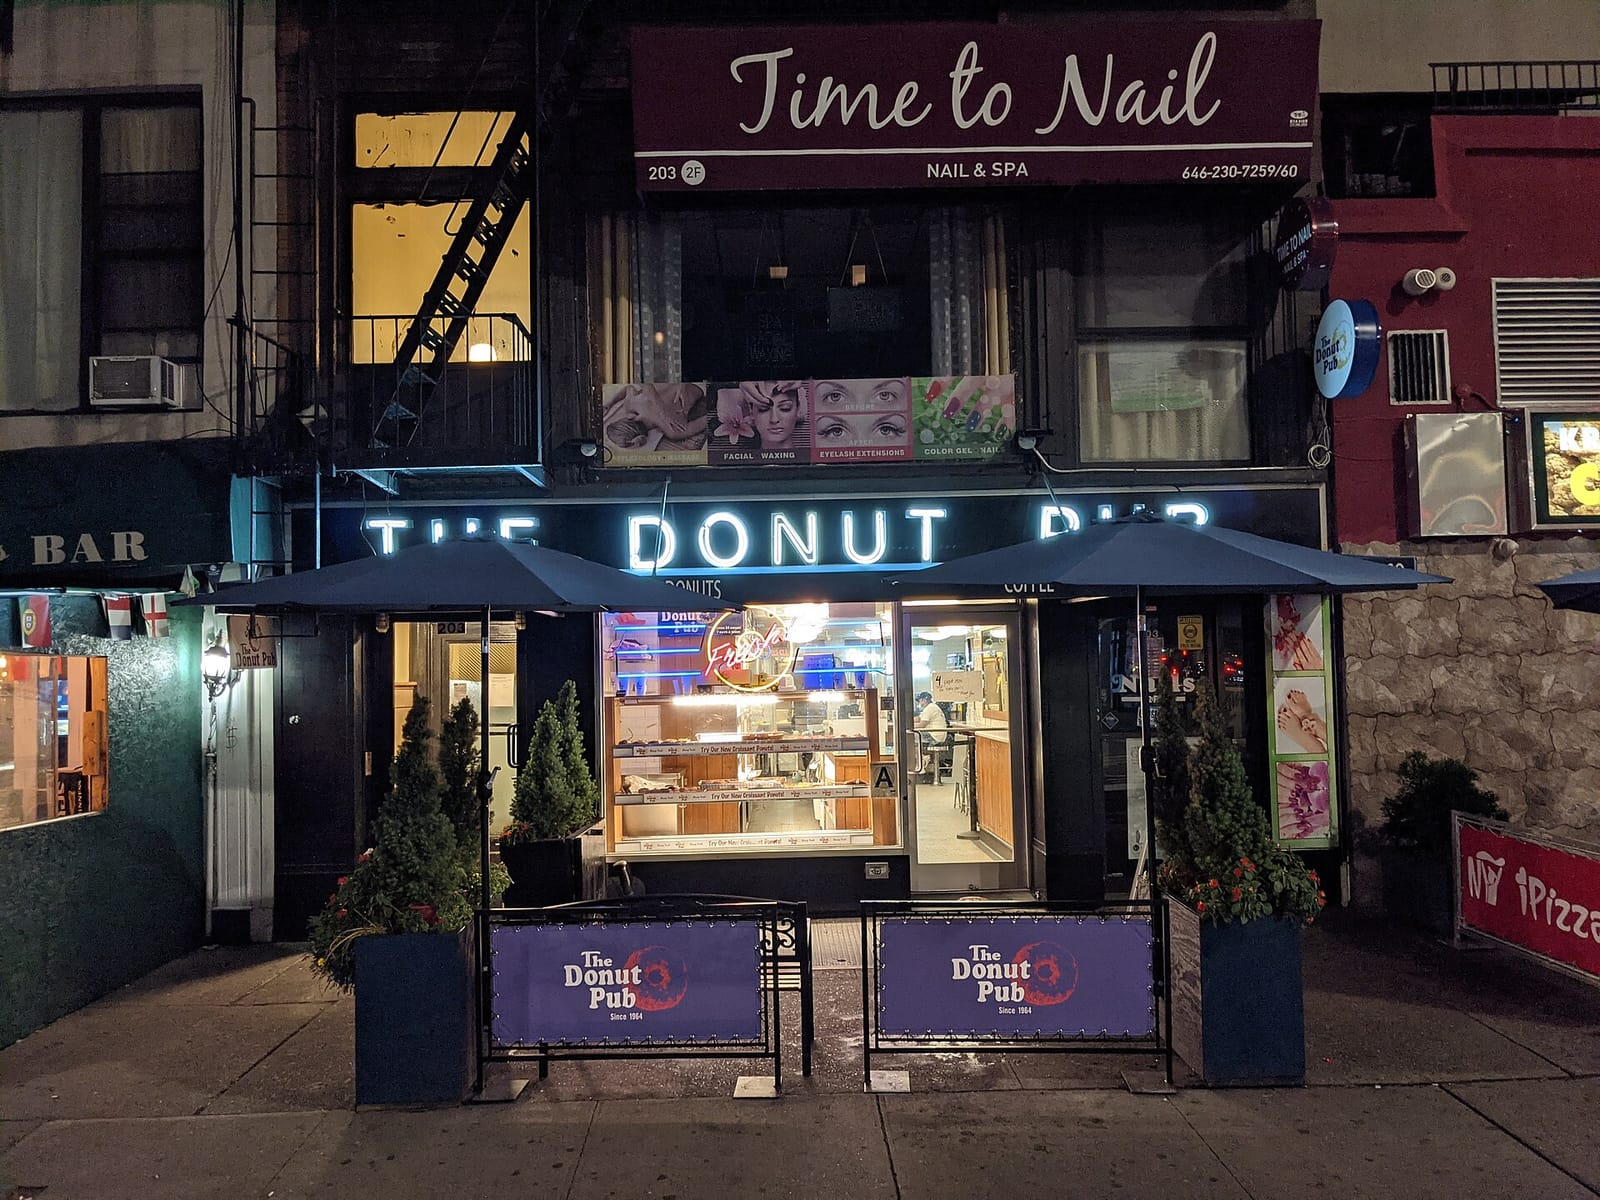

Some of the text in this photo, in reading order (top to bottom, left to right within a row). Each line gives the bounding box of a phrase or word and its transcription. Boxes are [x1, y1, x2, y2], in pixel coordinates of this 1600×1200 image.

[730, 31, 1220, 135] Time to Nail
[648, 166, 702, 180] 203 2F
[927, 162, 1028, 178] NAIL & SPA
[1182, 164, 1298, 179] 646-230-7259/60
[1277, 222, 1312, 263] TIME TO NAIL
[1321, 335, 1331, 347] The
[1316, 339, 1341, 364] Donut
[1323, 354, 1338, 375] Pub
[761, 451, 795, 460] WAXING
[819, 449, 905, 458] EYELASH EXTENSIONS
[924, 447, 953, 456] COLOR
[955, 447, 972, 455] GEL
[627, 508, 948, 570] DONUT
[31, 531, 149, 566] BAR
[438, 623, 465, 634] 203
[240, 643, 251, 655] The
[235, 651, 275, 667] Donut Pub
[935, 675, 942, 687] 4
[701, 746, 710, 754] Try
[874, 766, 893, 788] A
[581, 951, 613, 967] The
[969, 944, 1001, 961] The
[564, 964, 642, 986] Donut
[951, 958, 1031, 980] Donut
[589, 987, 637, 1009] Pub
[977, 981, 1025, 1002] Pub
[610, 1012, 643, 1020] Since 1964
[999, 1006, 1032, 1014] Since 1964
